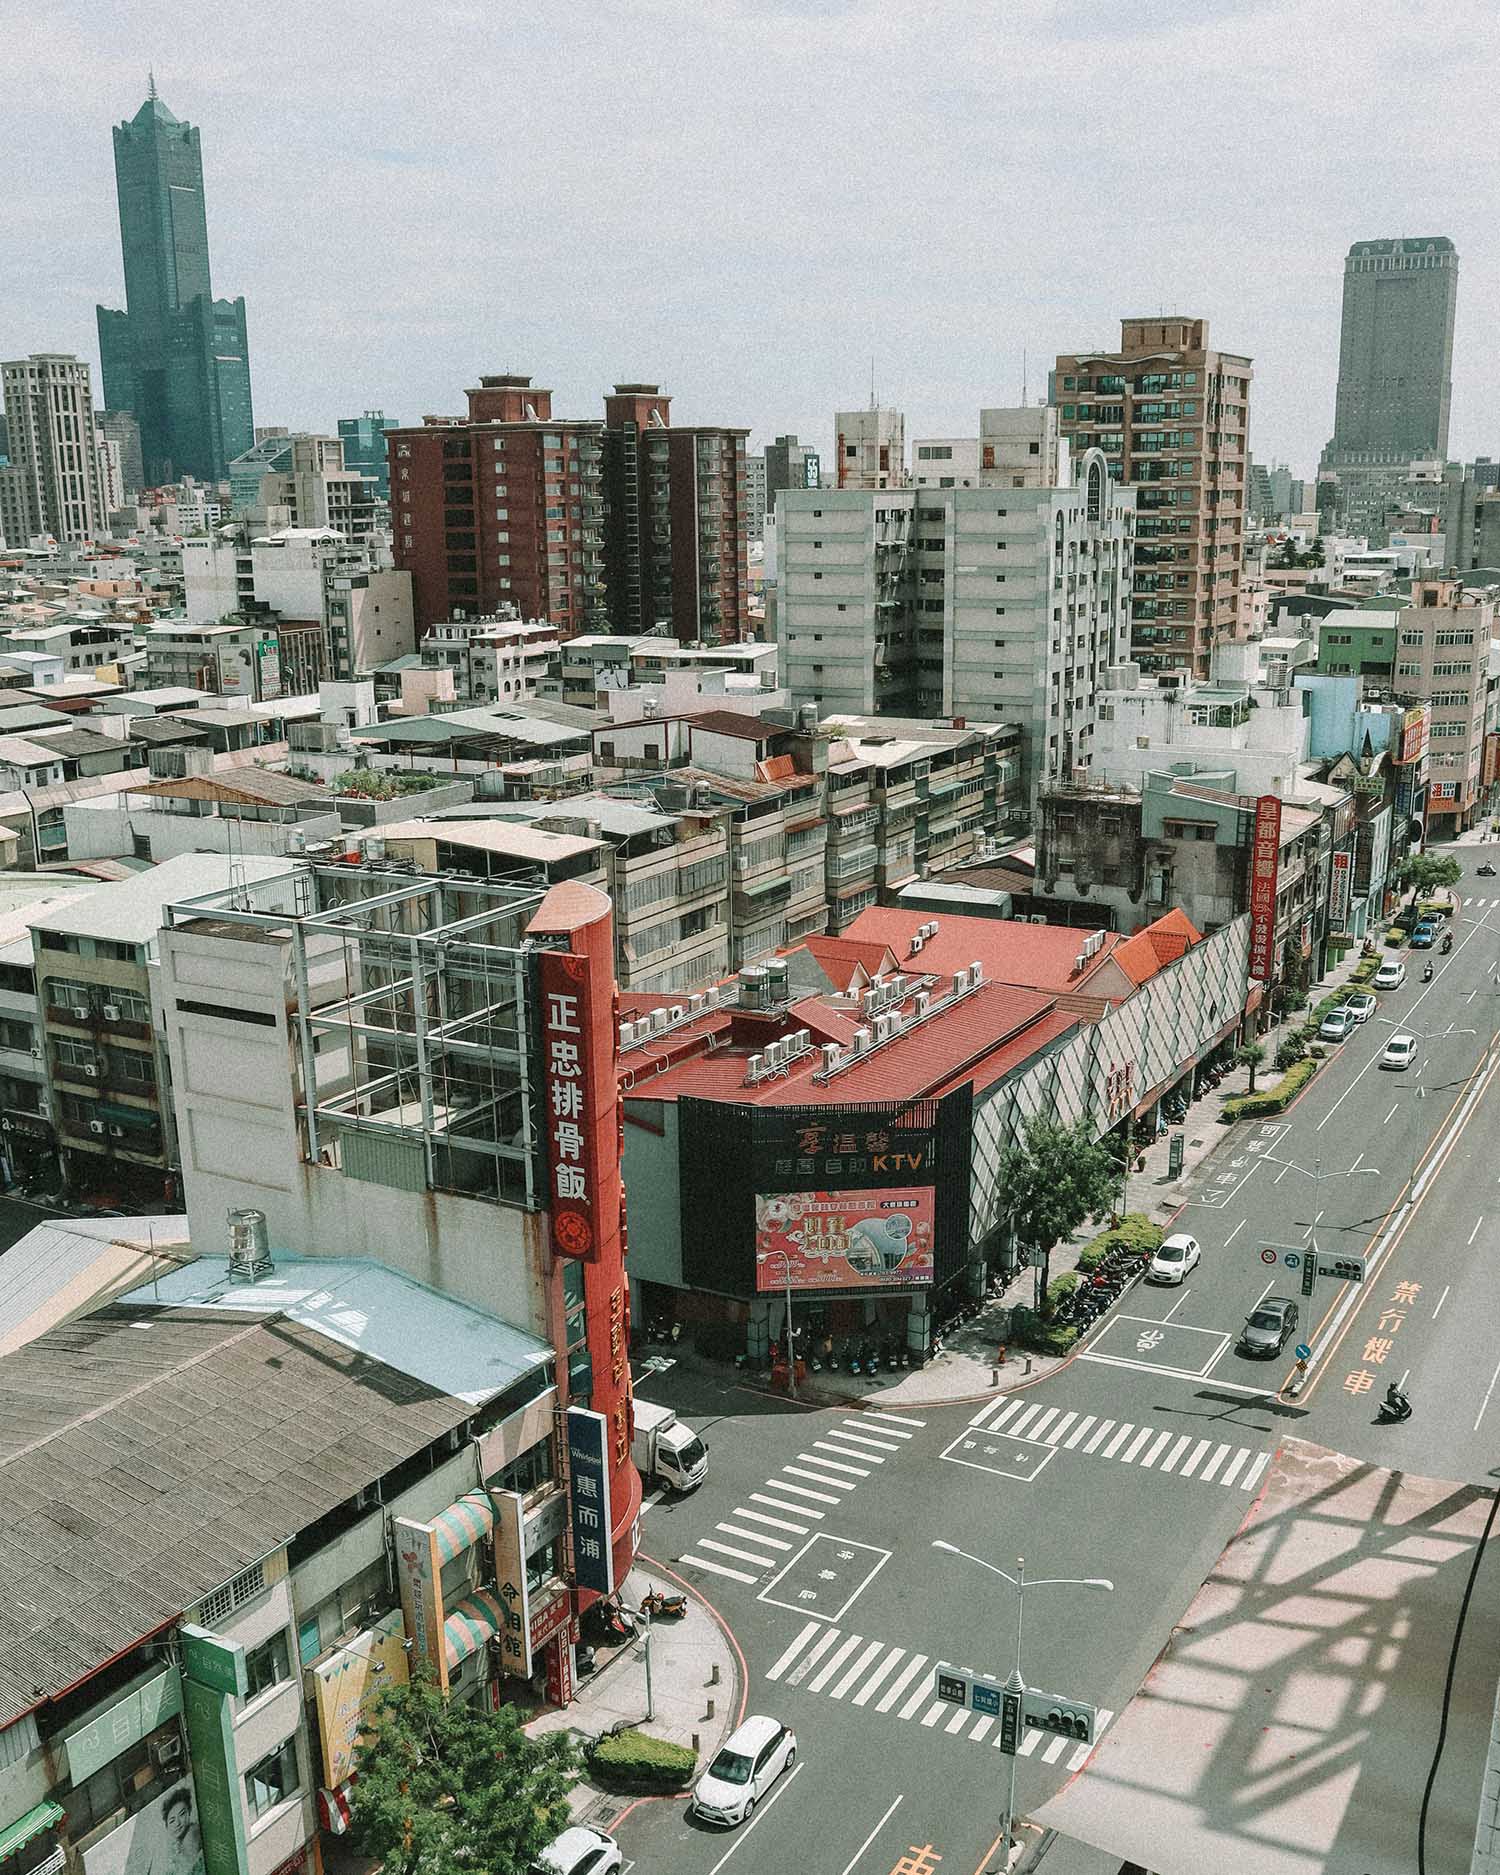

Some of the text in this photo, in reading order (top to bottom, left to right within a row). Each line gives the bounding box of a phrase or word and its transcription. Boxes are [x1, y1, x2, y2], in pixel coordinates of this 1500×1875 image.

[1255, 801, 1278, 878] 皇都音響
[547, 993, 588, 1200] 正忠排骨飯
[872, 1152, 923, 1172] KTV
[1343, 1280, 1423, 1395] 禁行機車
[577, 1474, 600, 1559] 惠而浦
